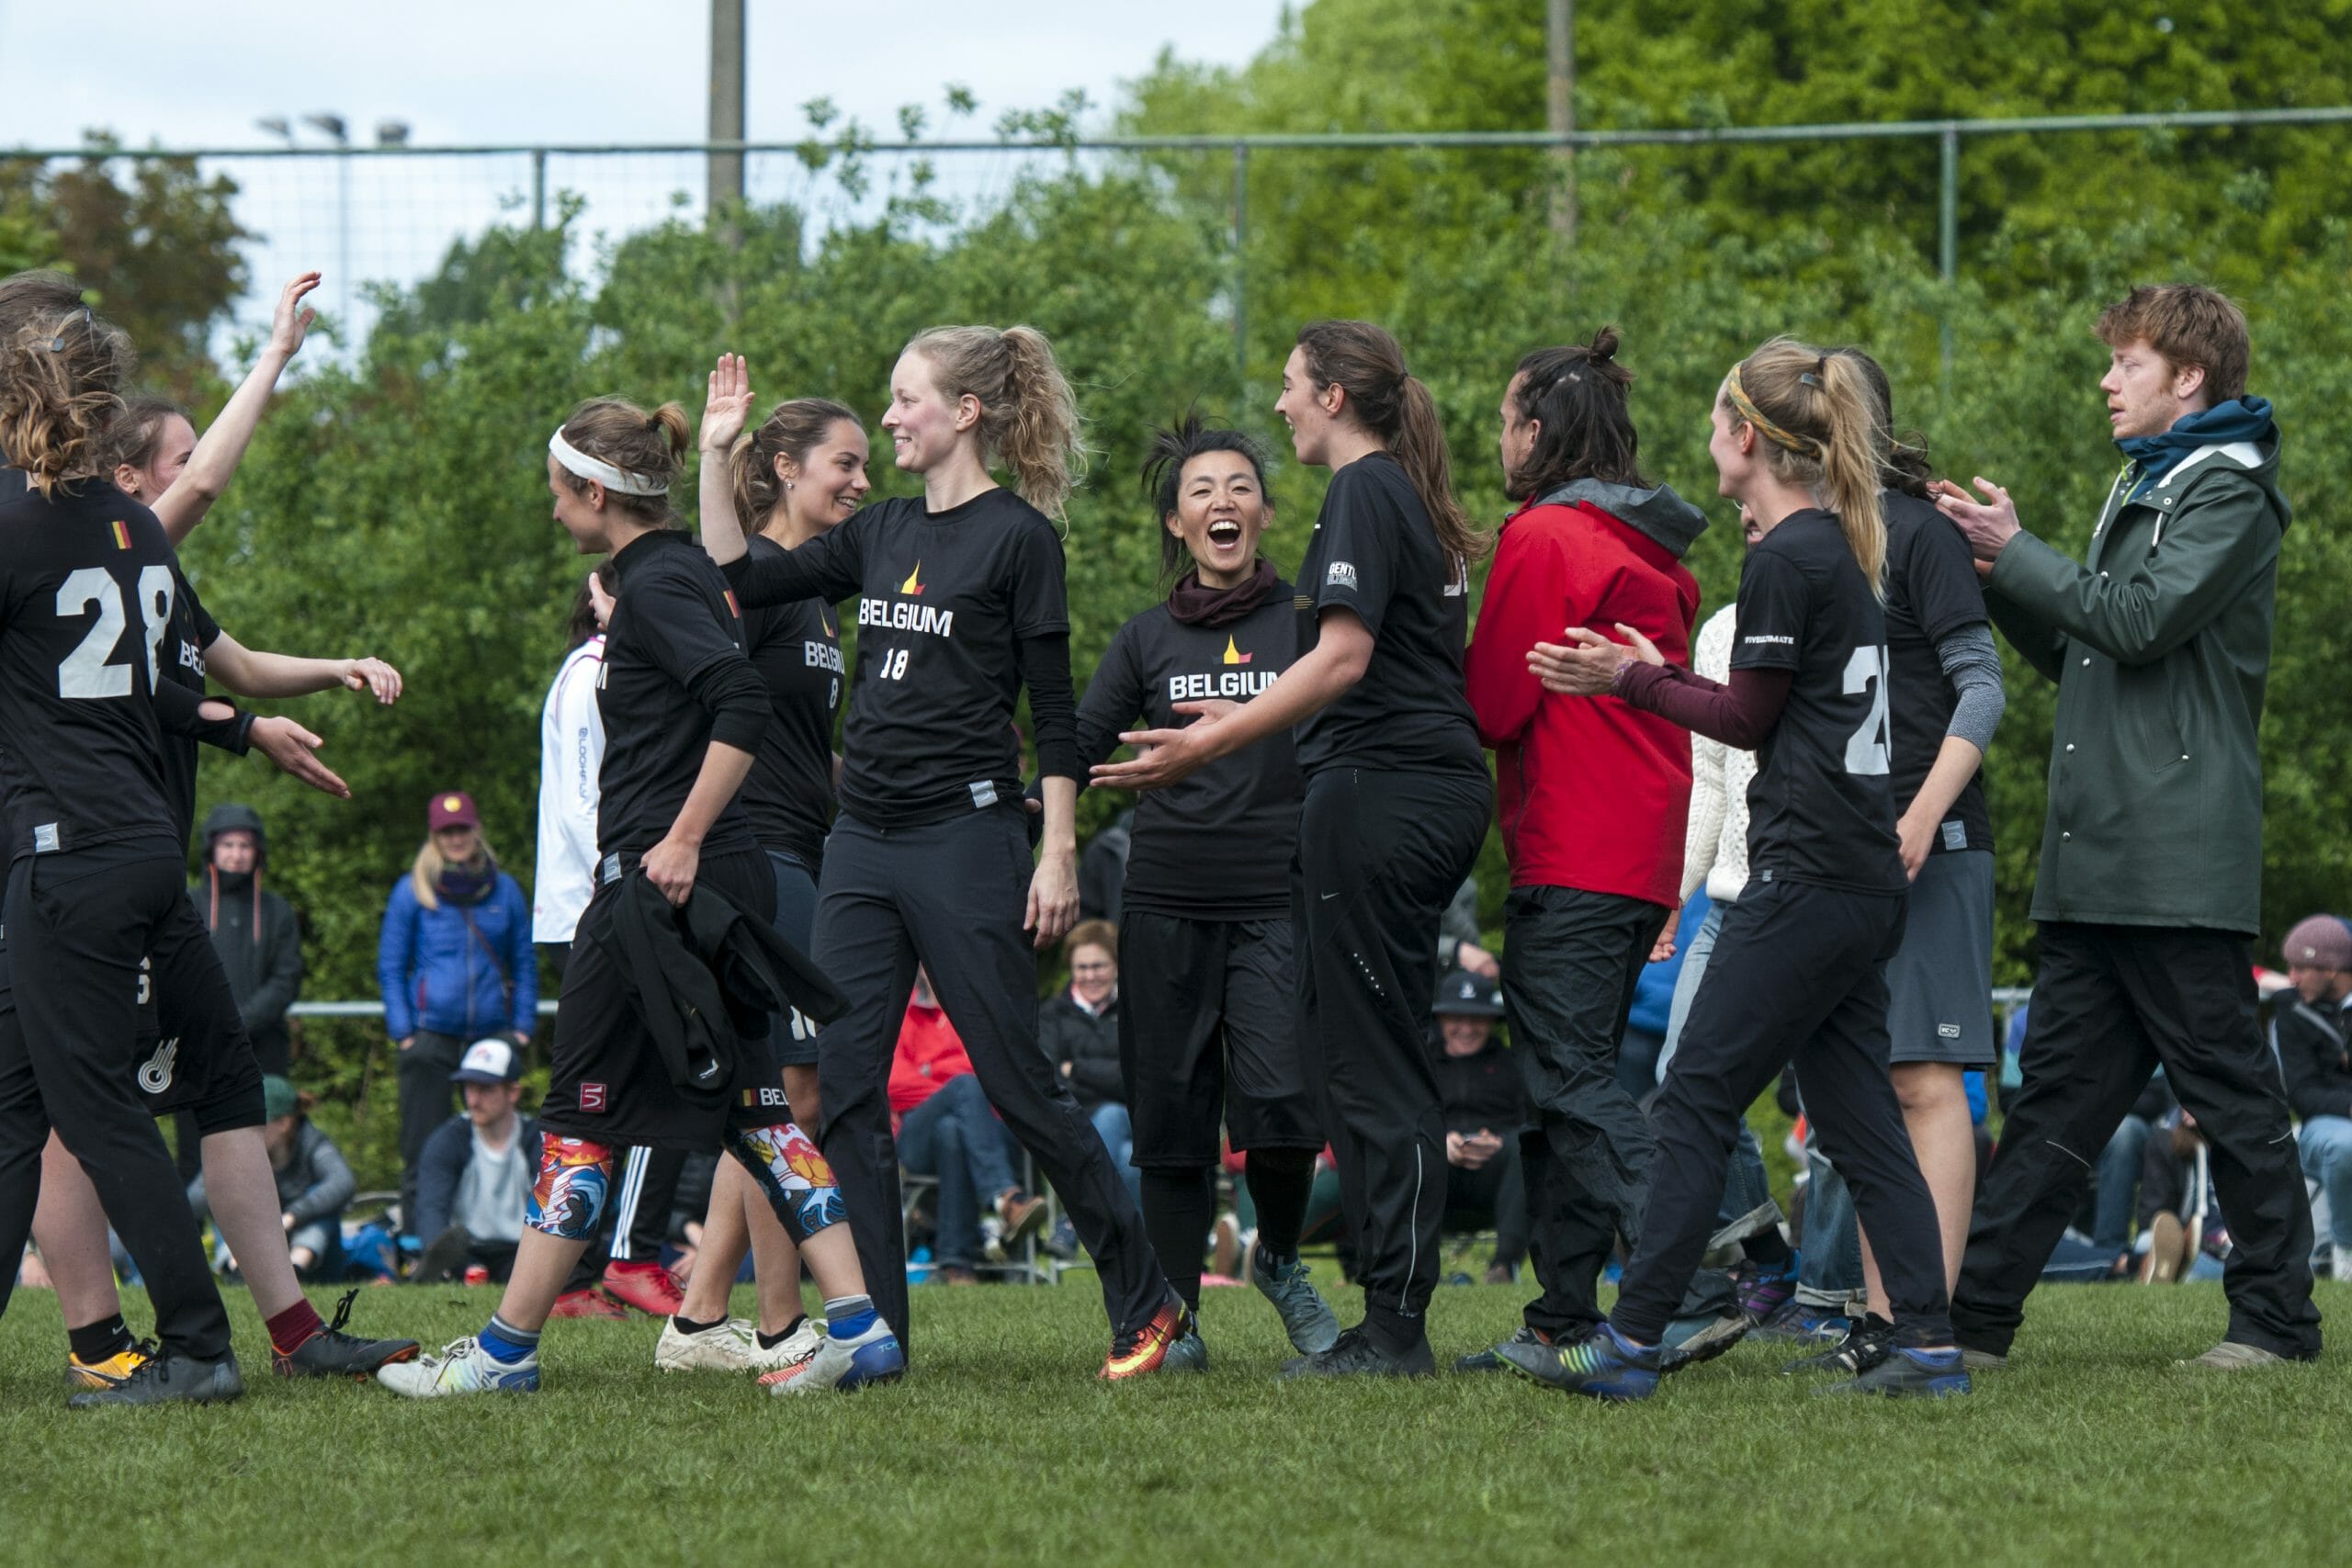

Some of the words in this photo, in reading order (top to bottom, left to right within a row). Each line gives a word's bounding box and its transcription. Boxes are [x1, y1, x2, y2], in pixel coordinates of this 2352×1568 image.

[56, 565, 175, 698] 28
[858, 598, 954, 637] BELGIUM
[879, 648, 909, 680] 18
[829, 678, 838, 708] 8
[1843, 645, 1892, 775] 2
